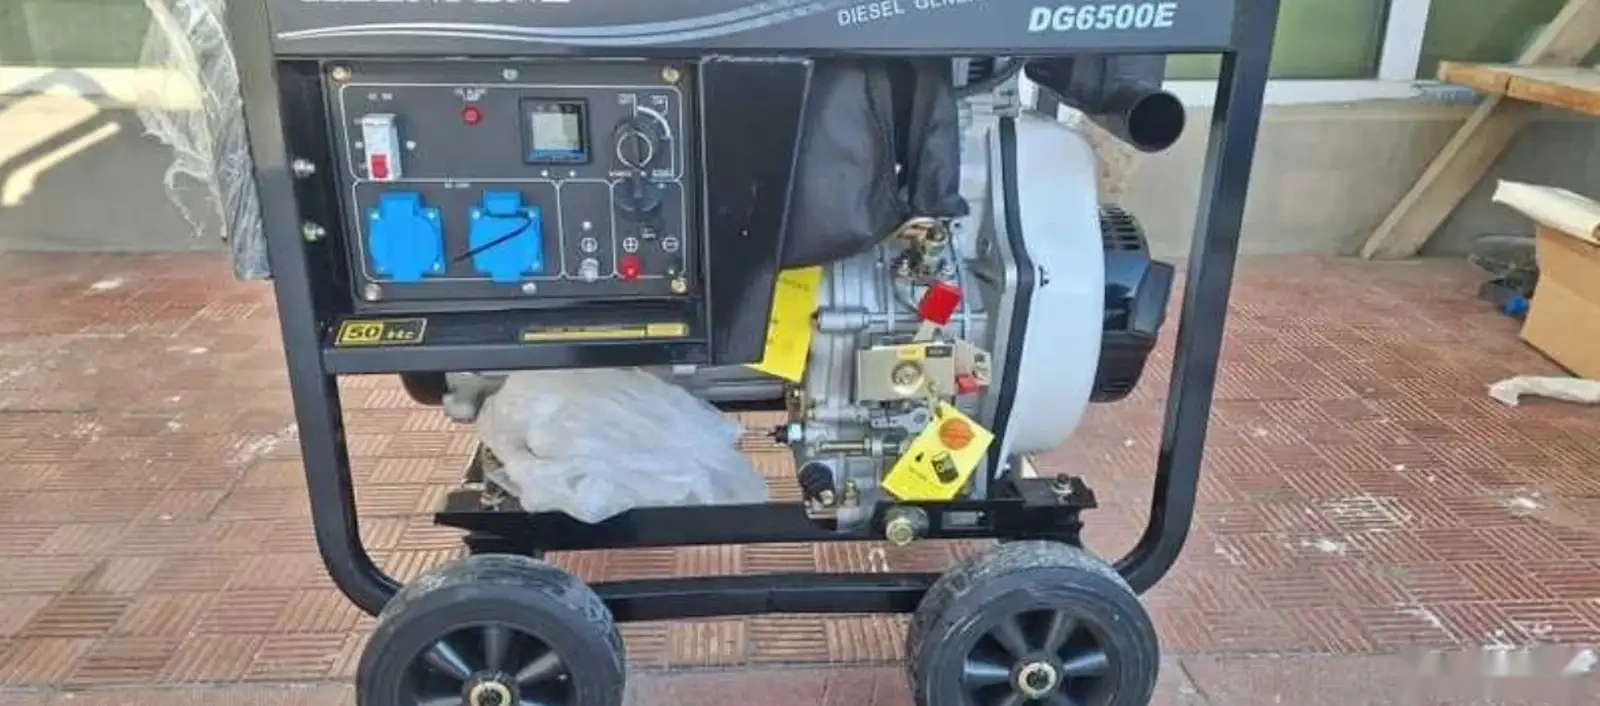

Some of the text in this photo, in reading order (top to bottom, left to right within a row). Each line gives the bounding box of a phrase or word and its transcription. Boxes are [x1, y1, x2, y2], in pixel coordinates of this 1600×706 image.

[837, 0, 905, 25] DIESEL
[1027, 2, 1176, 32] DG6500E
[349, 326, 380, 338] 50
